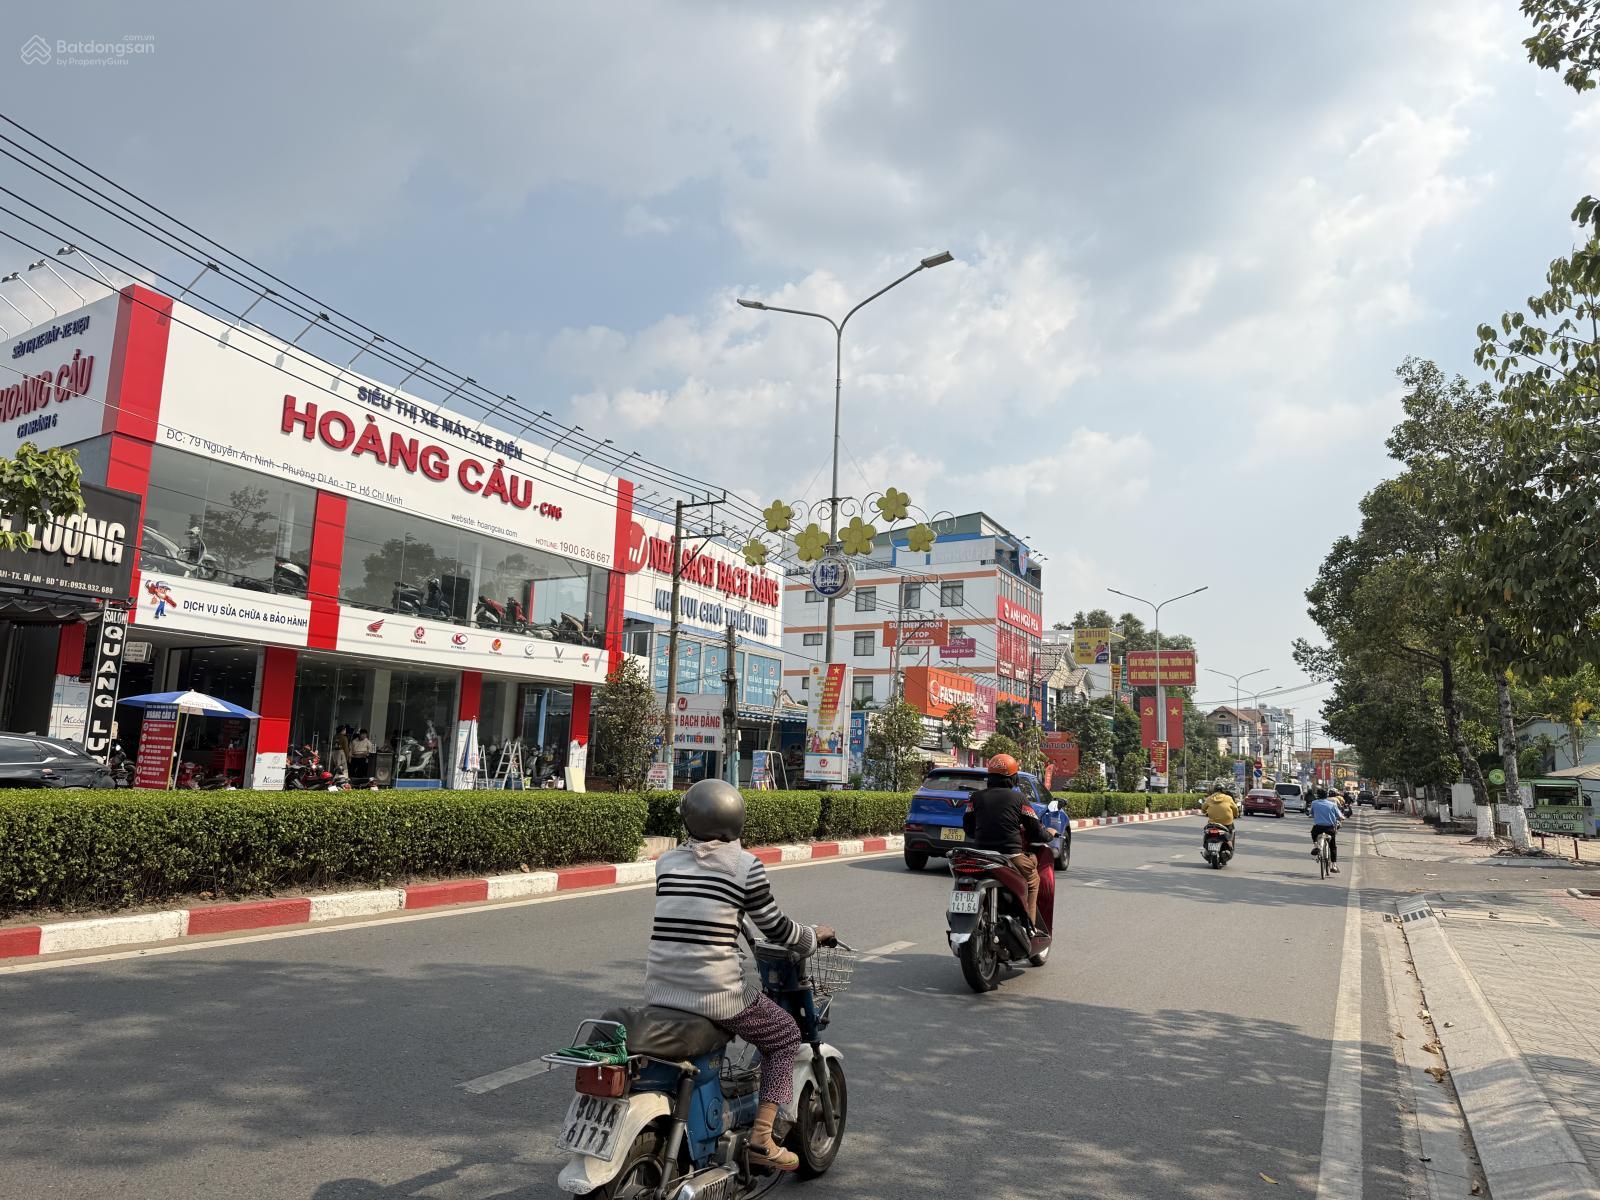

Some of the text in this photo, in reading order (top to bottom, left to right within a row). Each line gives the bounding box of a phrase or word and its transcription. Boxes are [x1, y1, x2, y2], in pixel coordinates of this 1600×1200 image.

[281, 394, 450, 481] HOÀNG
[357, 386, 392, 411] SIÊU
[395, 399, 418, 424] THỊ
[420, 409, 439, 428] XE
[495, 439, 523, 460] ĐIỆN
[166, 428, 186, 443] ĐC:
[188, 435, 201, 446] 79
[203, 439, 238, 457] Nguyễn
[240, 451, 253, 462] An
[254, 455, 275, 469] Ninh
[328, 477, 339, 487] An
[386, 493, 403, 506] Minh
[27, 510, 126, 565] LƯỢNG
[451, 513, 518, 538] website: hoangcau.com
[559, 541, 579, 556] 1900
[580, 547, 595, 561] 636
[596, 550, 611, 564] 667
[681, 544, 716, 588] SÁCH
[716, 560, 749, 599] BẠCH
[105, 610, 128, 624] SALON
[183, 600, 205, 612] DỊCH
[206, 603, 219, 616] VỤ
[269, 612, 286, 624] BẢO
[287, 615, 308, 627] HÀNH
[655, 588, 769, 637] KH VUI CHƠI THIẾU NHI
[94, 625, 124, 708] QUANG
[679, 715, 699, 730] BẠCH
